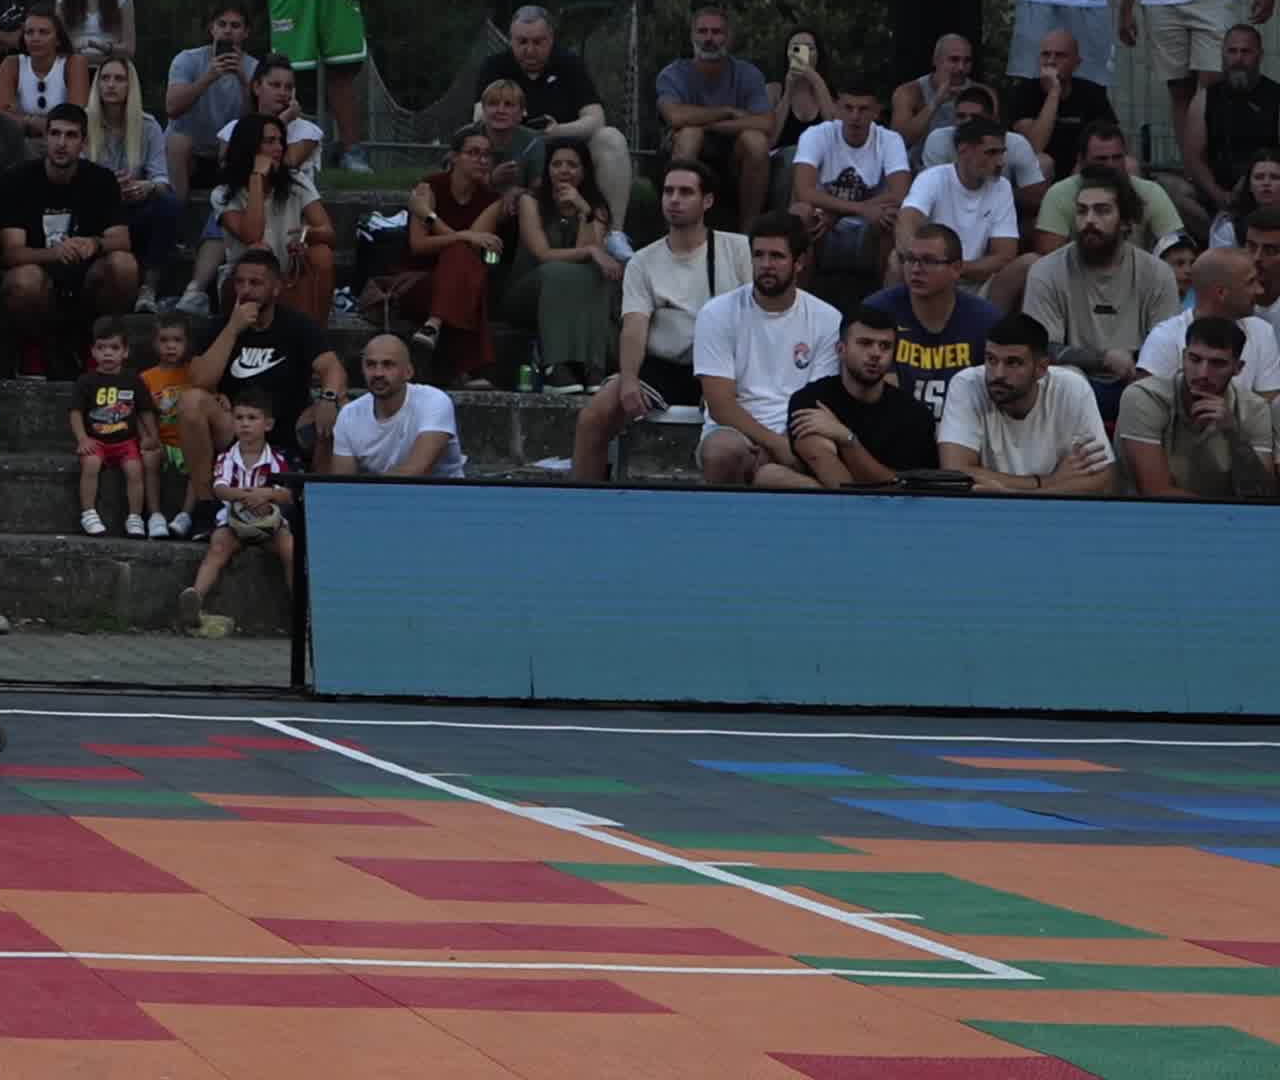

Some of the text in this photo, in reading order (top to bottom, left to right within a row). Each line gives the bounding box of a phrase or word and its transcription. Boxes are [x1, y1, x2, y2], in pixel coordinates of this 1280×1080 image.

[241, 347, 276, 367] NIKE
[896, 338, 971, 370] DENVER
[96, 386, 118, 406] 68
